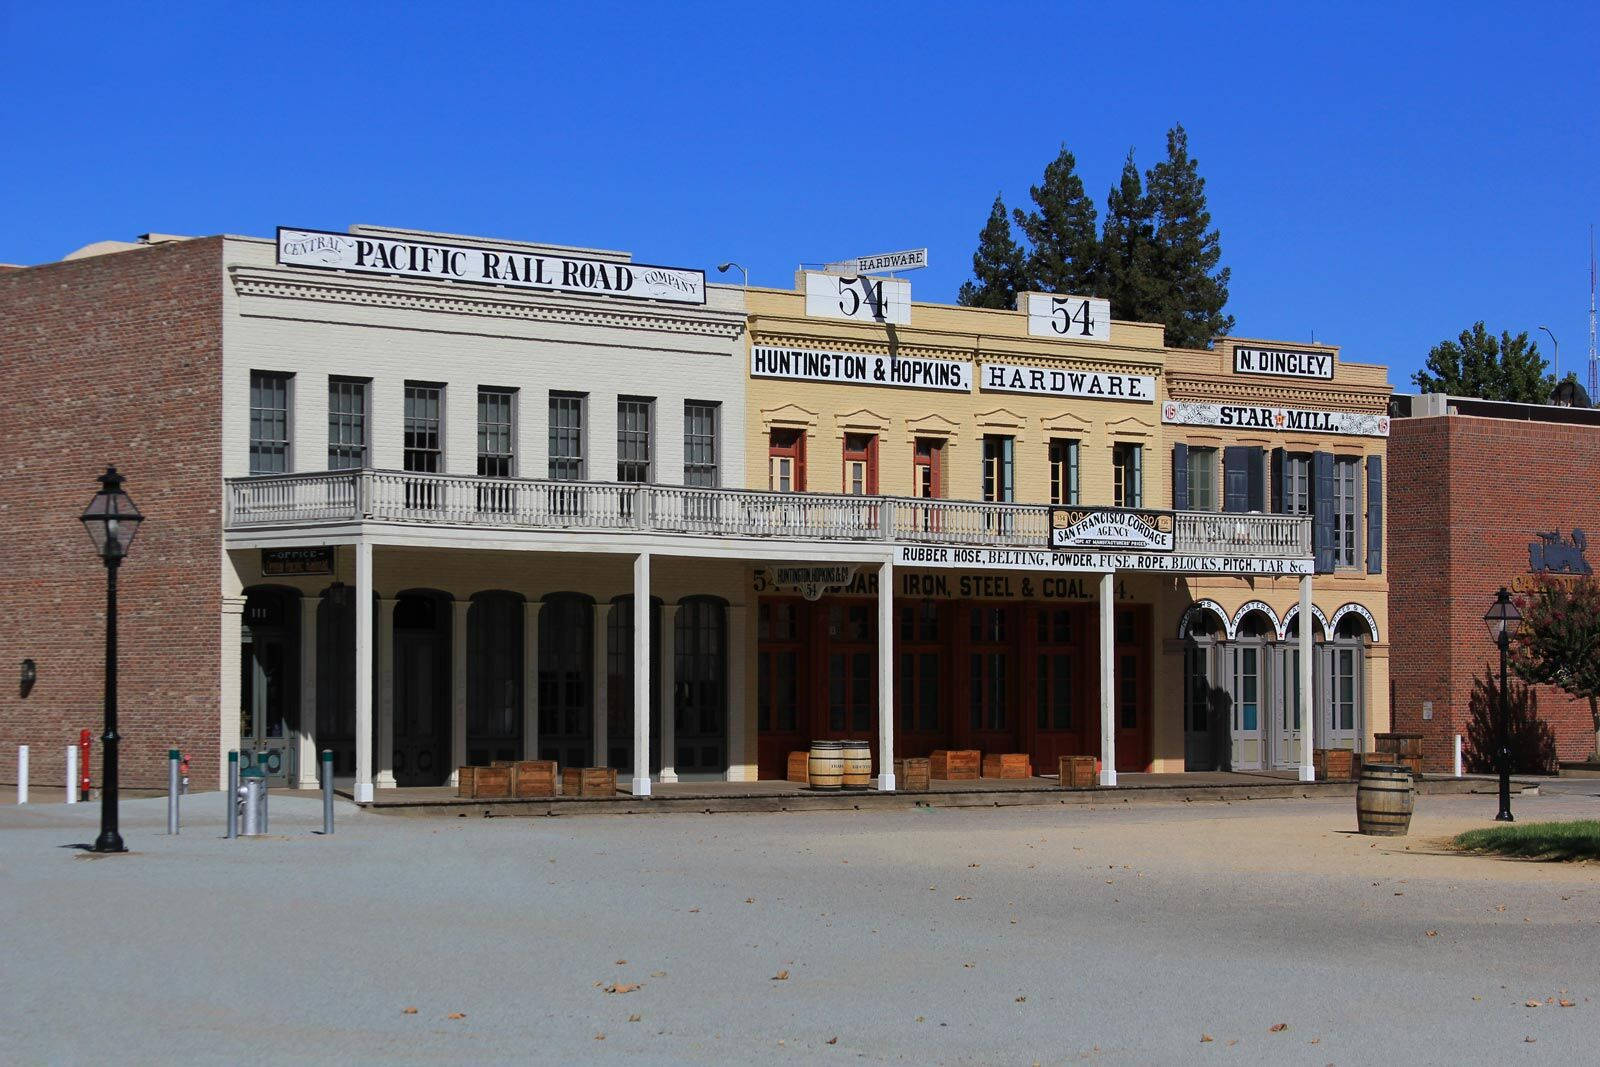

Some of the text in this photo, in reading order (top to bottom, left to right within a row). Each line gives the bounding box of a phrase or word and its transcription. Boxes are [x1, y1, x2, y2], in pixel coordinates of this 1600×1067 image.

[283, 236, 697, 295] CENTRAL PACIFIC RAIL ROAD COMPANY
[859, 252, 923, 271] HARDWARE
[838, 277, 888, 319] 54
[1051, 297, 1095, 336] 54
[755, 348, 866, 380] HUNTINGTON
[874, 358, 886, 382] &
[1240, 350, 1328, 376] N. DINGLEY.
[989, 367, 1147, 398] HARDWARE.
[1220, 406, 1274, 427] STAR
[1287, 410, 1339, 432] MILL.
[1058, 512, 1167, 546] SAN FRANCISCO CORDAGE
[1097, 526, 1129, 537] AGENCY
[902, 547, 948, 563] RUBBER
[953, 548, 985, 565] HOSE,
[988, 549, 1048, 567] BELTING,
[1051, 552, 1096, 569] POWDER,
[1100, 554, 1134, 570] FUSE,
[1137, 555, 1168, 572] ROPE,
[1171, 557, 1221, 573] BLOCKS,
[1223, 558, 1257, 573] PITCH,
[1260, 560, 1286, 573] TAR
[811, 568, 834, 583] HOPKINS
[903, 575, 951, 598] IRON,
[960, 576, 1013, 597] STEEL
[1022, 577, 1034, 597] &
[1042, 578, 1093, 599] COAL.
[1215, 607, 1228, 625] AND
[1232, 602, 1271, 626] ROASTERS
[1311, 606, 1328, 627] OFFEE
[1331, 605, 1351, 628] SPICES
[1360, 607, 1376, 632] SYRUP
